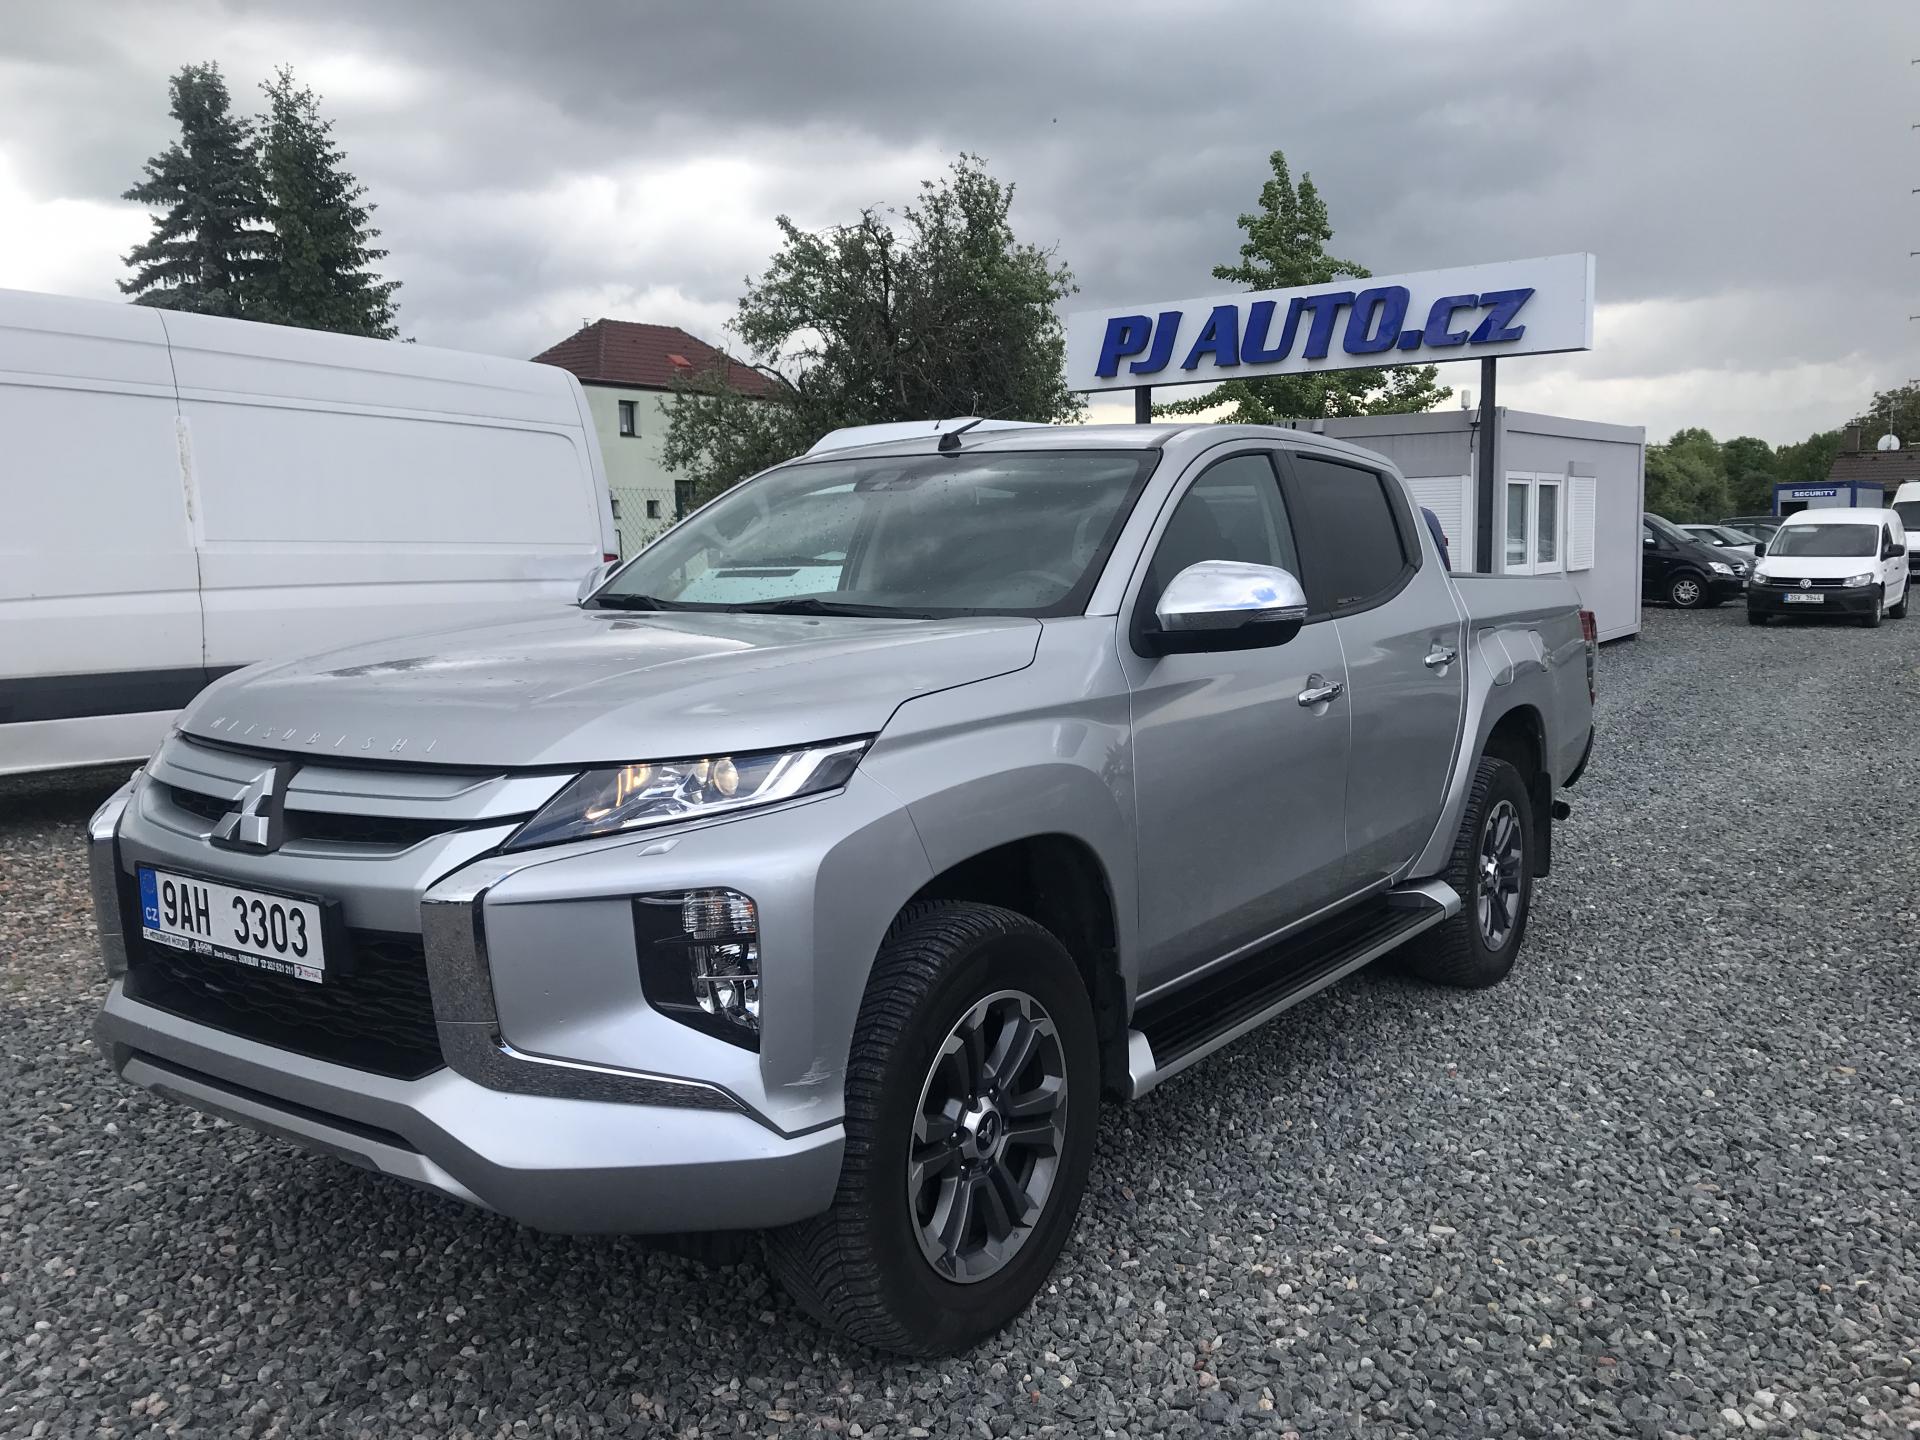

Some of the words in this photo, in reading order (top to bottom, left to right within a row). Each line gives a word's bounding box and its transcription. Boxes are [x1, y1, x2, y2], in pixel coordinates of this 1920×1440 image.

[1094, 311, 1183, 378] PJ
[1180, 285, 1537, 371] AUTO.CZ
[145, 906, 158, 922] CZ
[162, 880, 212, 937] 9AH
[232, 895, 308, 958] 3303
